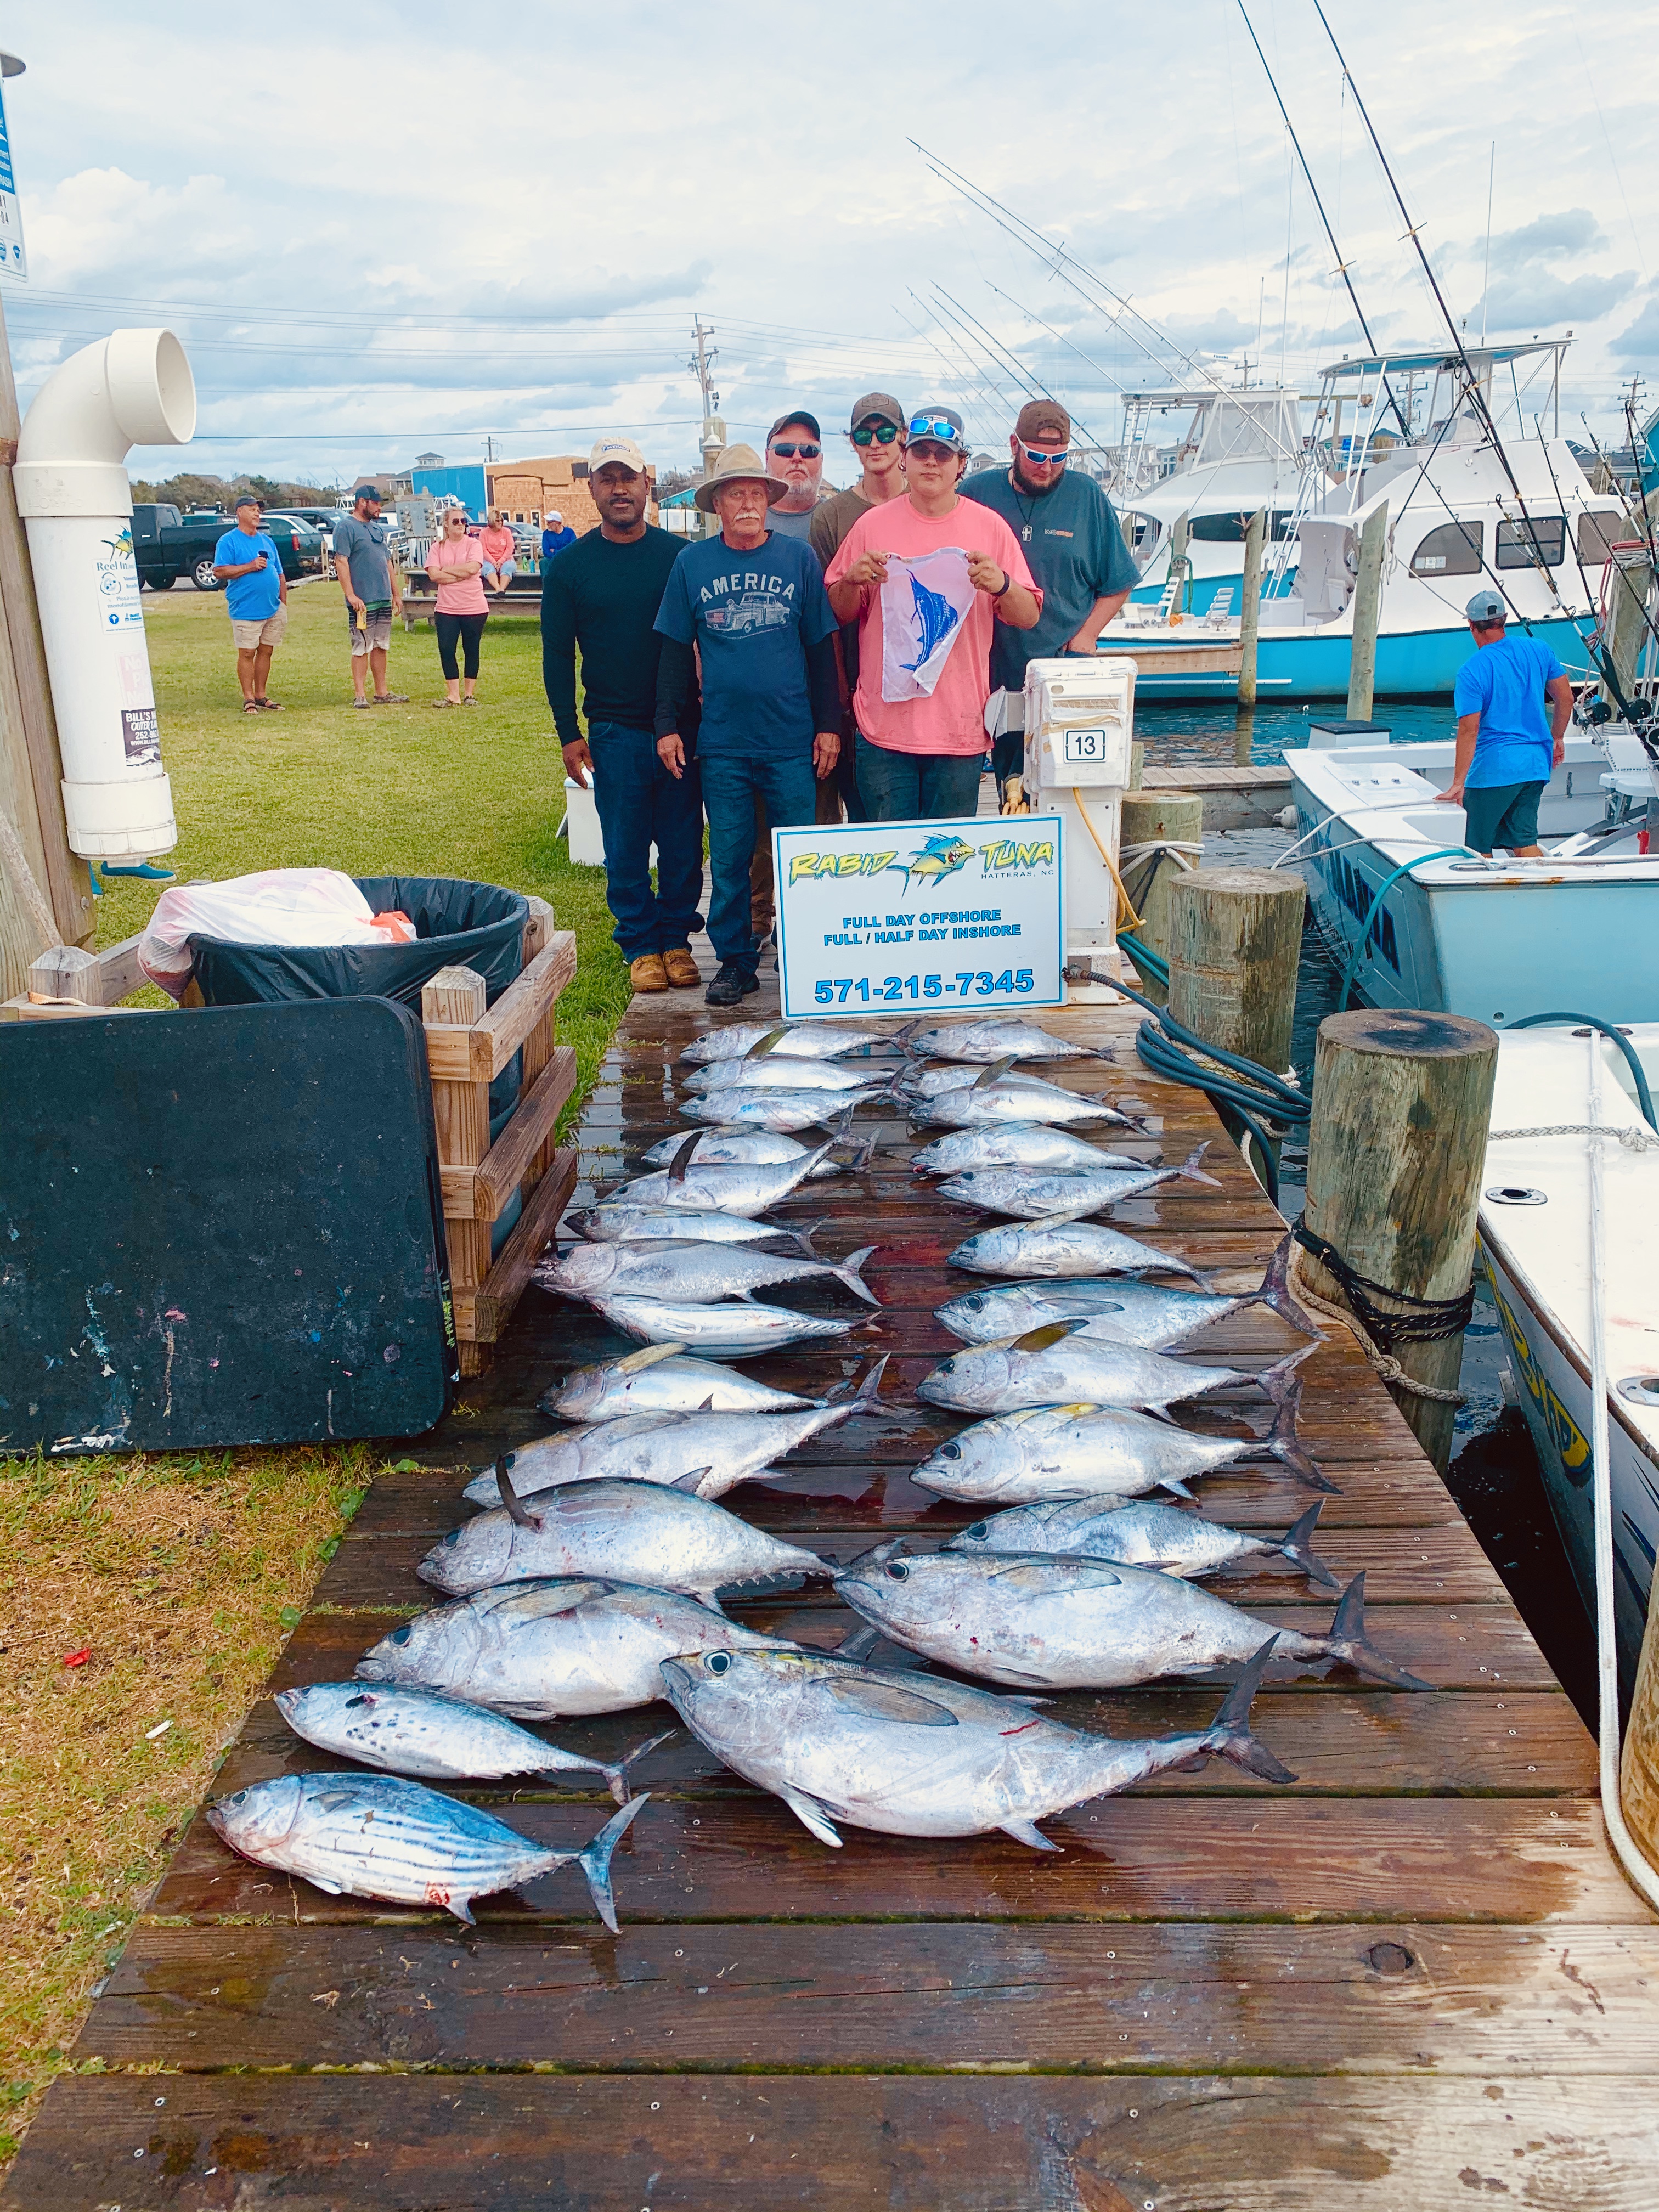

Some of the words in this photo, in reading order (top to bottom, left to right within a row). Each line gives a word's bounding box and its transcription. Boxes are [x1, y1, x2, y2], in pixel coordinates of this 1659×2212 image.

[97, 561, 118, 571] Reel
[701, 573, 795, 603] AMERICA
[126, 712, 151, 723] BILL'S
[131, 721, 150, 731] OUTER
[1075, 736, 1096, 755] 13
[790, 850, 899, 885] RABID
[979, 840, 1054, 870] TUNA
[843, 916, 881, 929] FULL
[886, 914, 916, 927] DAY
[919, 909, 1001, 925] OFFSHORE
[824, 934, 862, 946] FULL
[866, 933, 871, 944] /
[875, 930, 914, 943] HALF
[919, 929, 949, 940] DAY
[953, 924, 1021, 939] INSHORE
[815, 969, 1034, 1003] 571-215-7345
